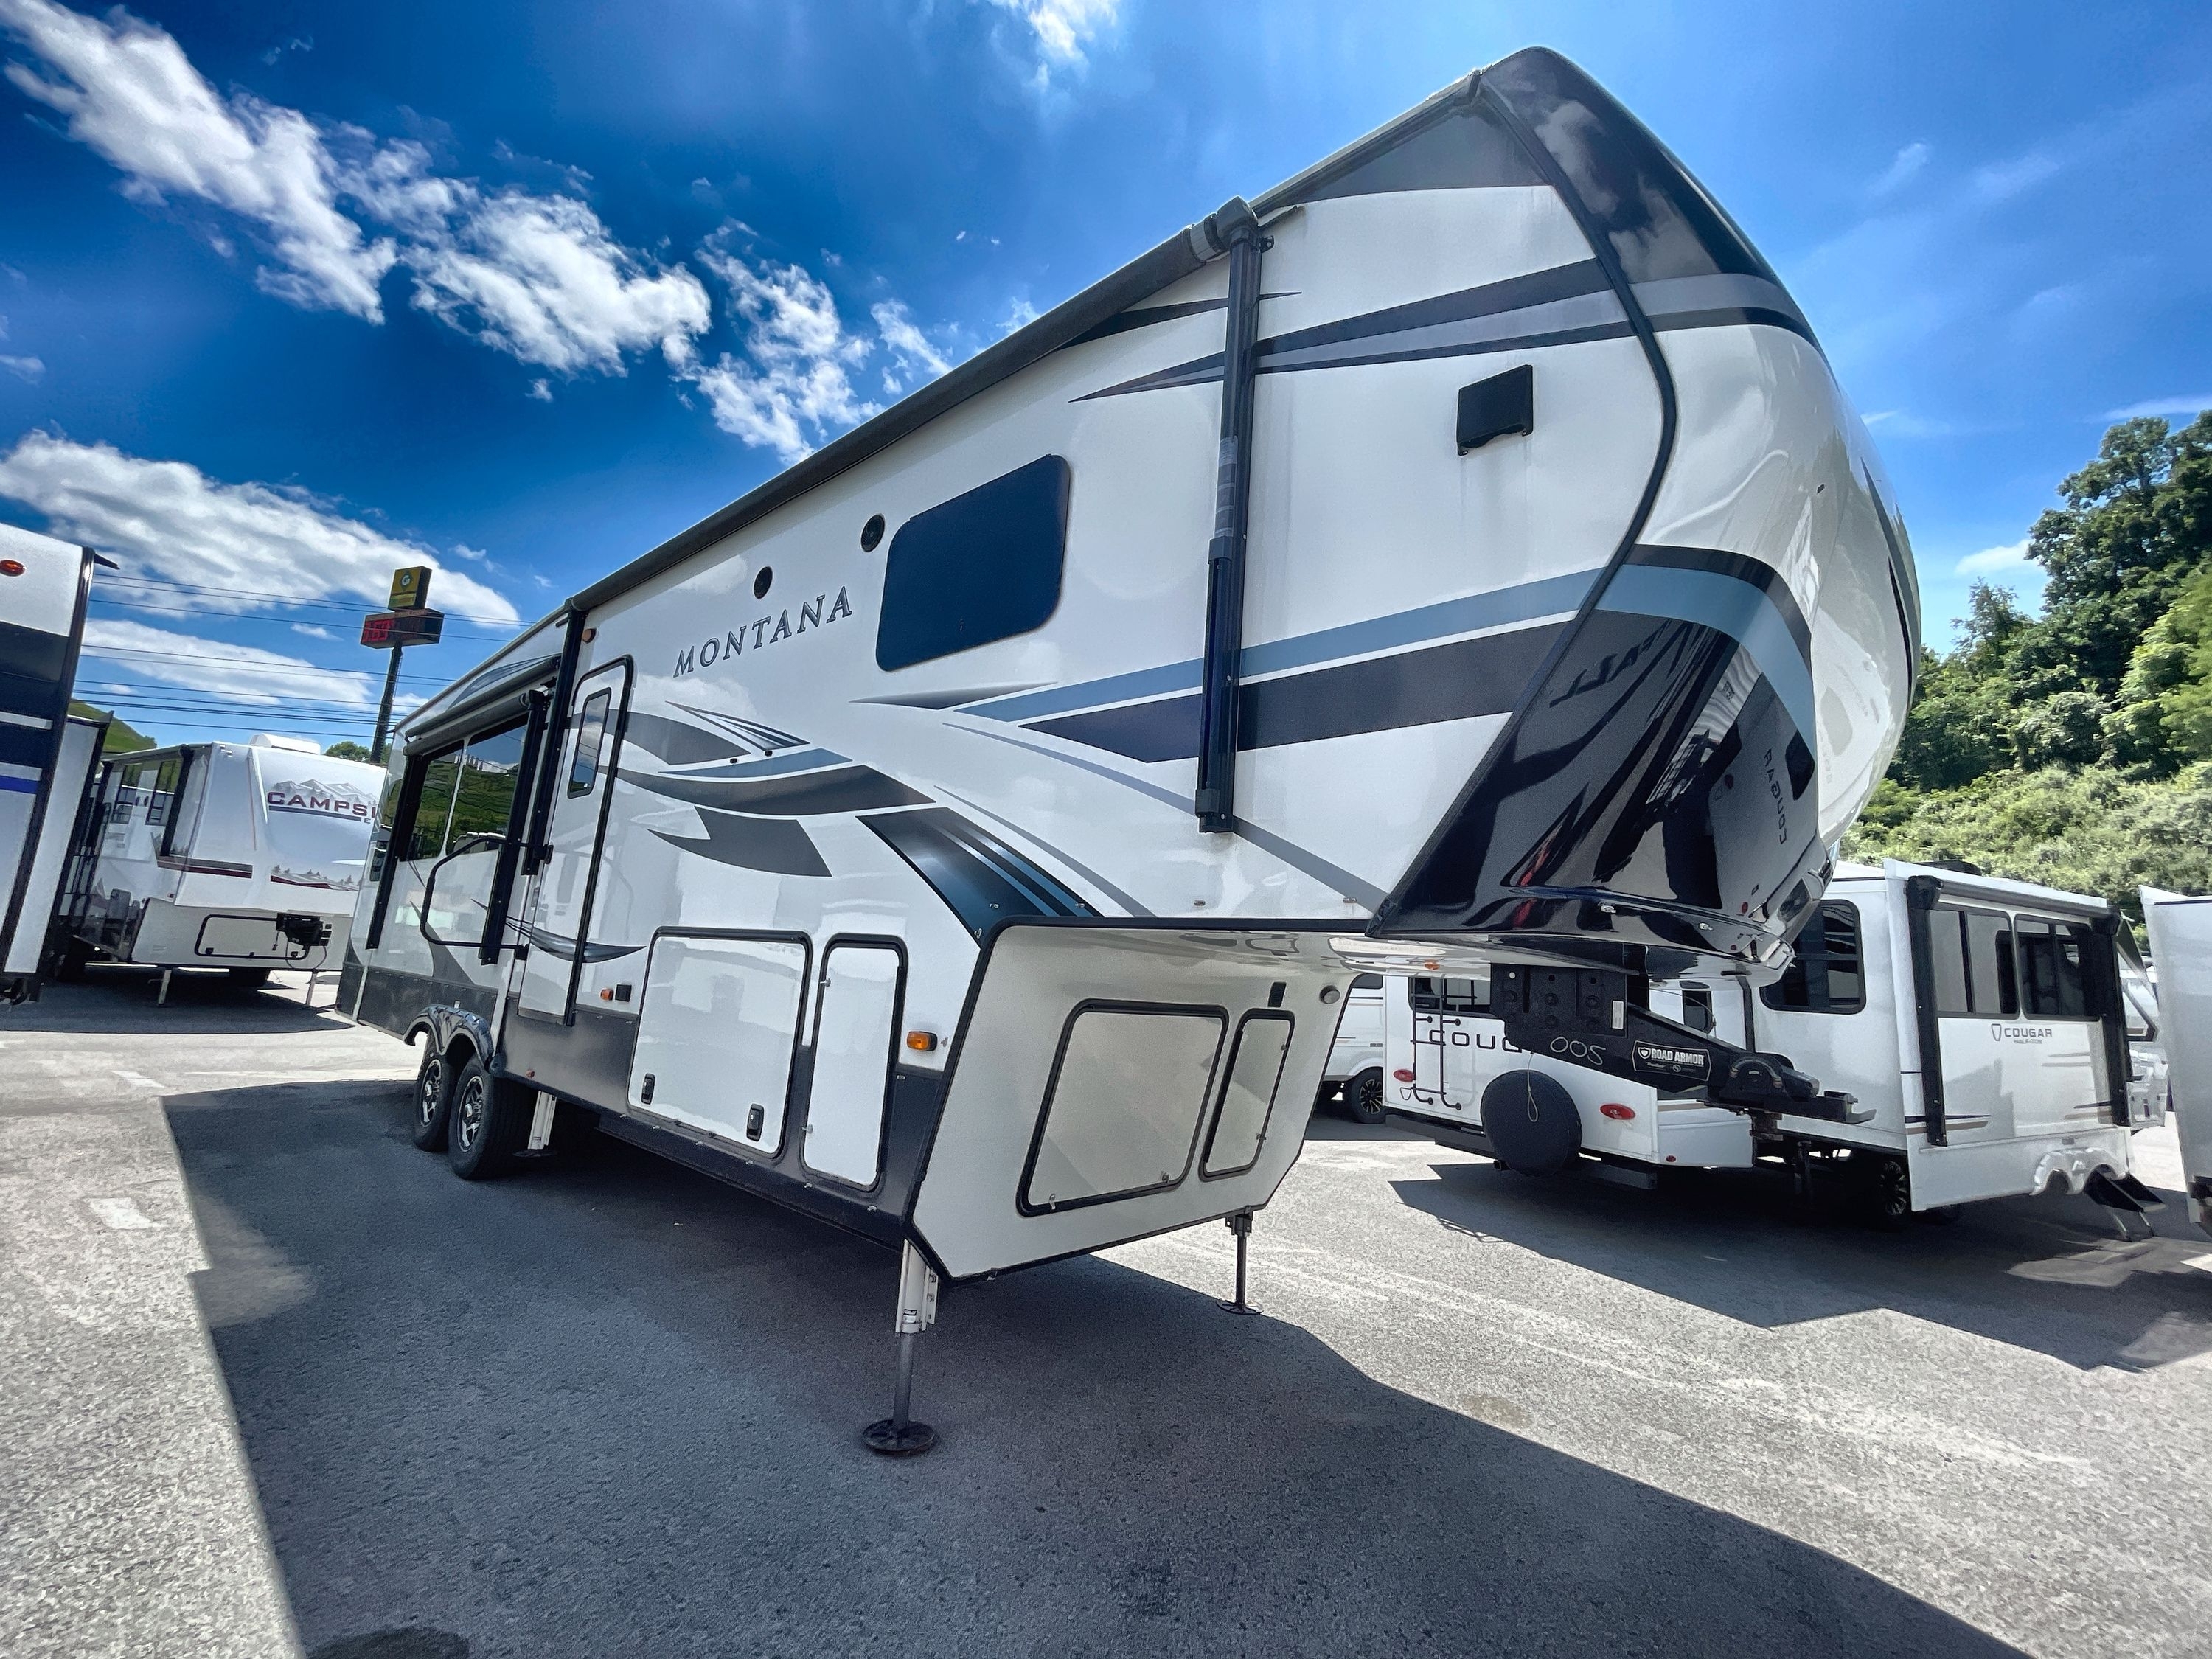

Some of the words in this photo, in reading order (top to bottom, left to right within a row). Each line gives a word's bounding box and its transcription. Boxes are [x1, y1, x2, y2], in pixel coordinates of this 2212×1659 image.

[673, 586, 852, 678] MONTANA
[268, 791, 376, 818] CAMPSI
[1429, 1029, 1534, 1054] COUG
[2004, 1028, 2053, 1038] COUGAR
[1651, 1048, 1674, 1061] ROAD
[1674, 1051, 1705, 1065] ARMOR
